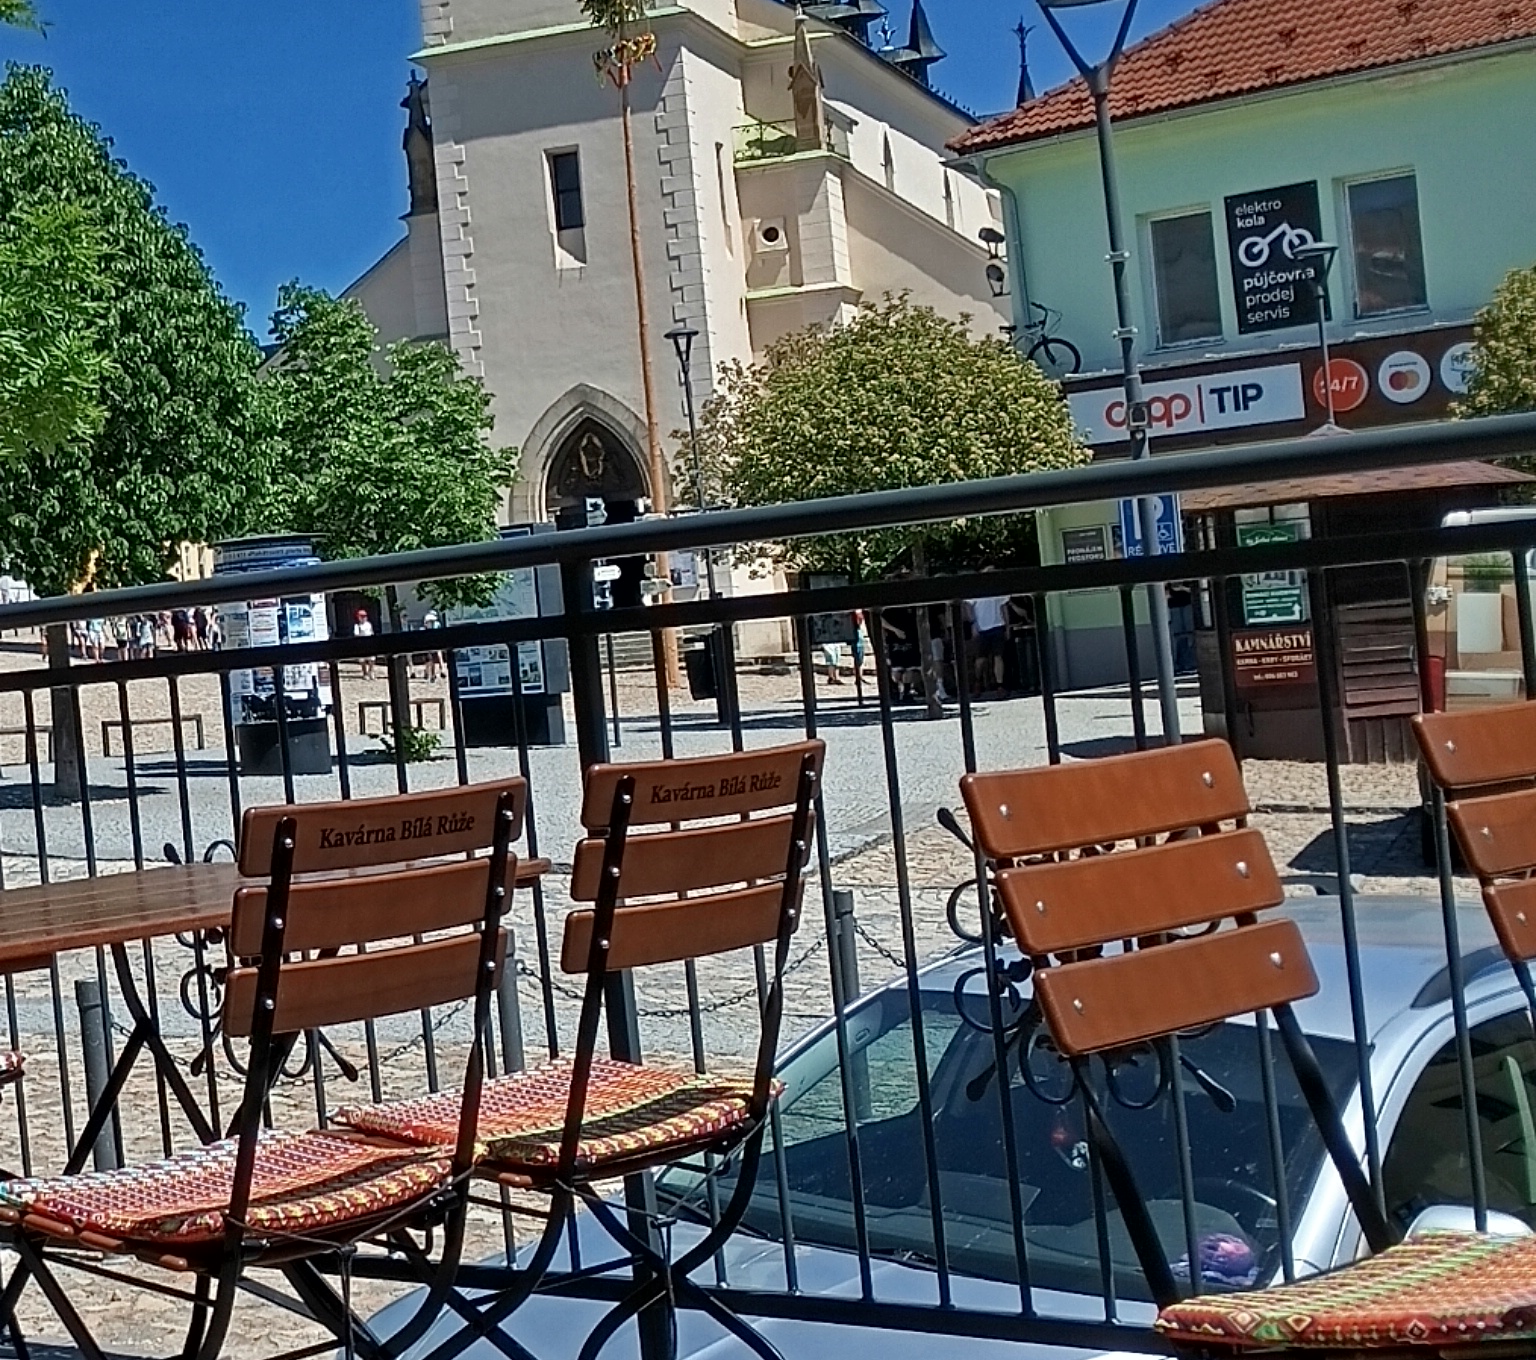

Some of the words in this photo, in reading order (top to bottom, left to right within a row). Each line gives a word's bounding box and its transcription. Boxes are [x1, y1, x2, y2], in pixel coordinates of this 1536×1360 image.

[1235, 199, 1282, 216] elektro
[1236, 215, 1265, 229] kola
[1246, 284, 1295, 309] prodej
[1247, 305, 1290, 324] servis
[1105, 393, 1192, 428] cop
[1209, 383, 1264, 414] TIP
[651, 781, 715, 804] Kavárna
[718, 774, 748, 797] Bílá
[749, 771, 782, 793] Růže
[319, 824, 395, 849] Kavárna
[400, 816, 433, 840] Bílá
[436, 811, 475, 836] Růže
